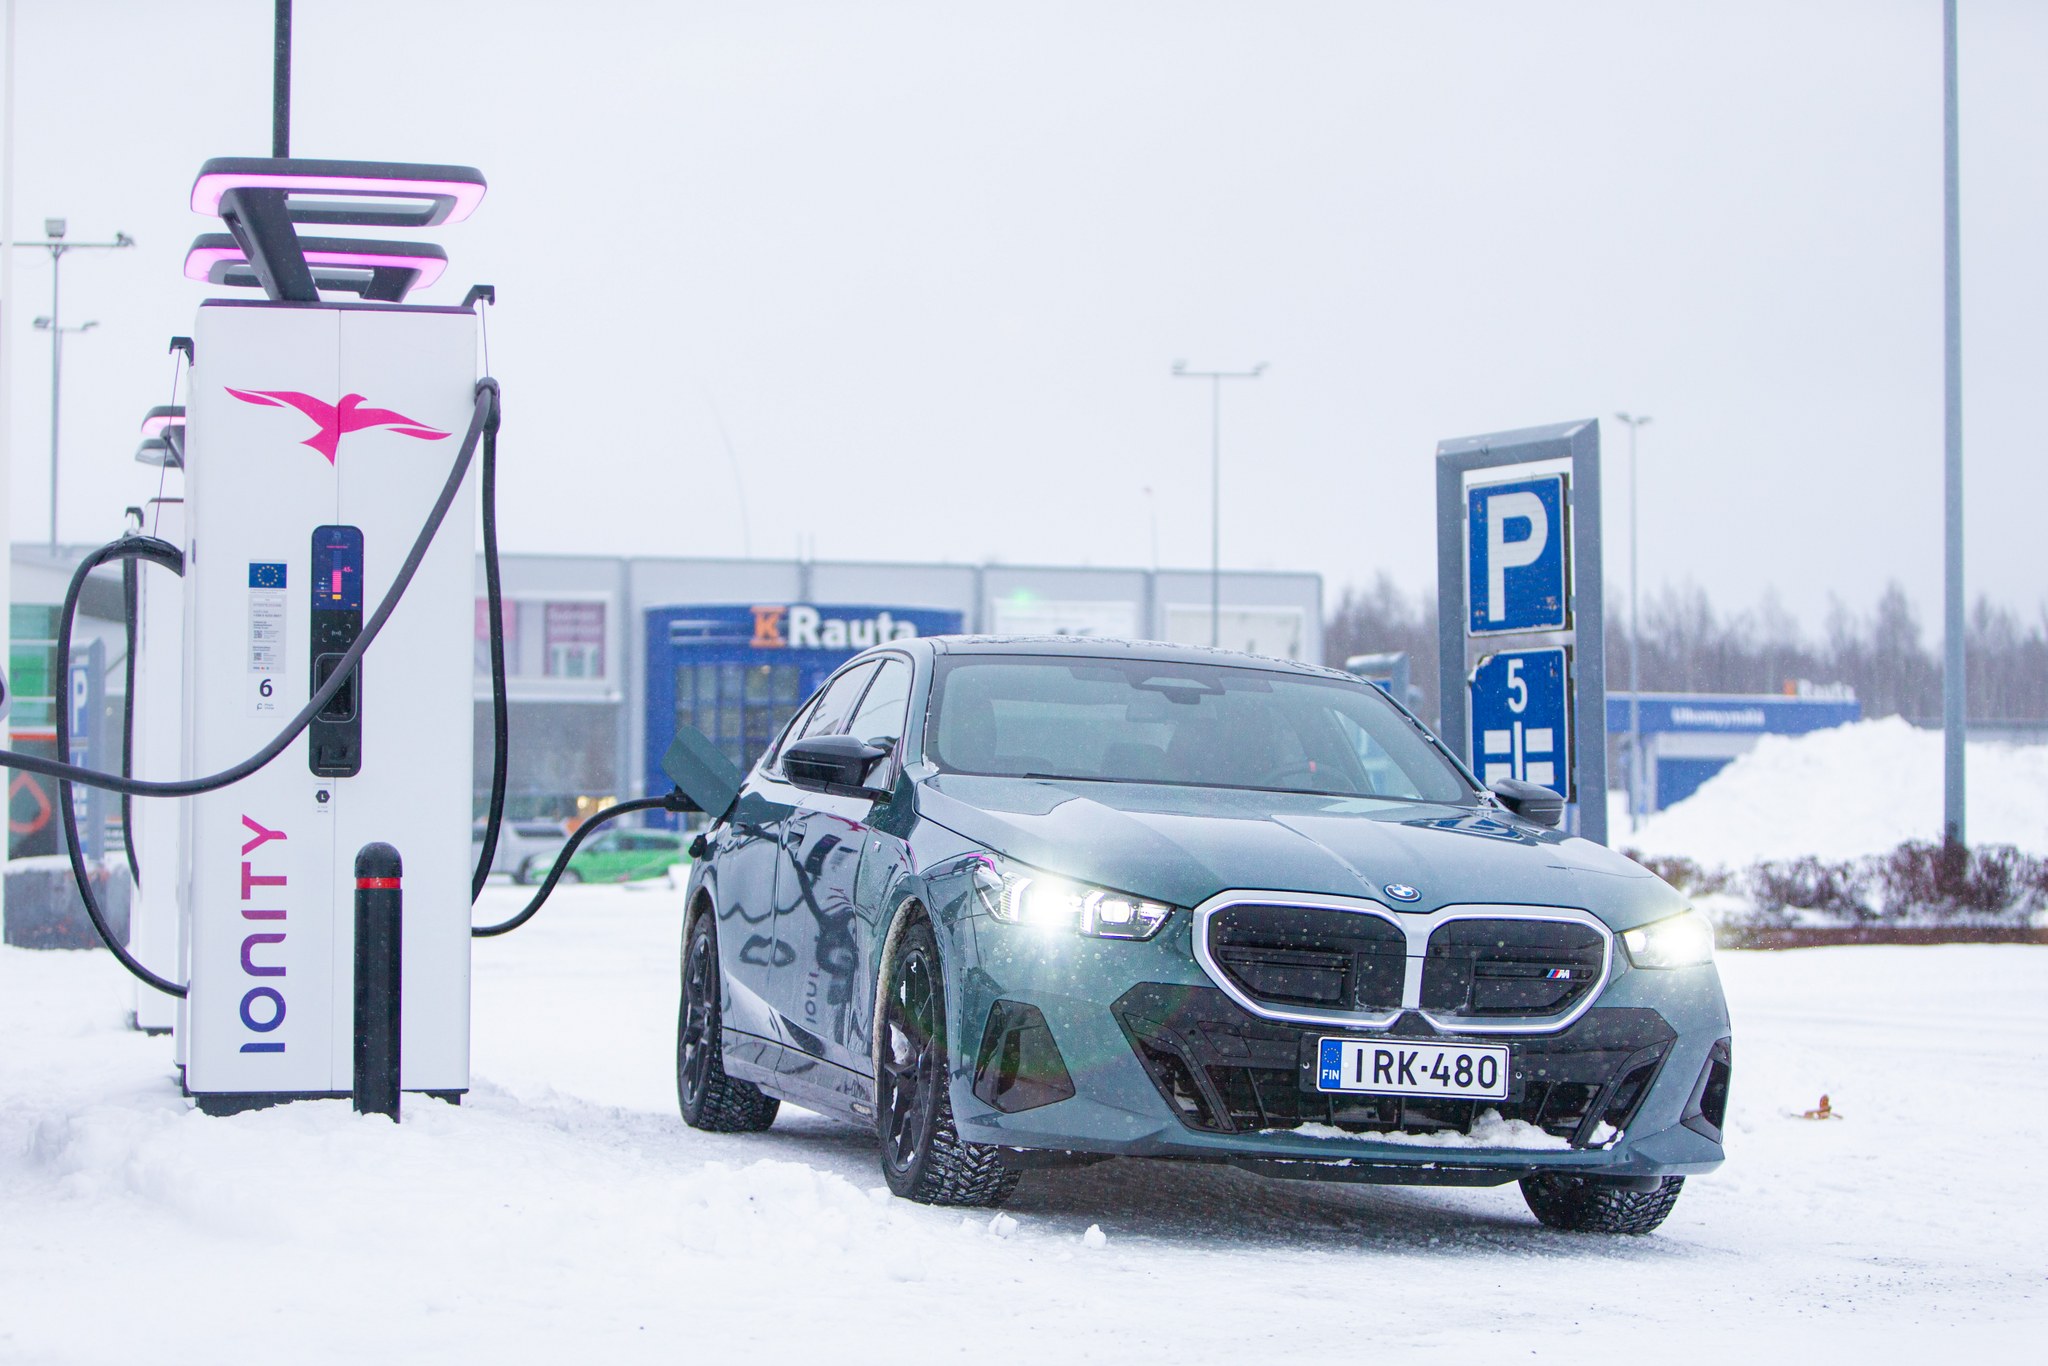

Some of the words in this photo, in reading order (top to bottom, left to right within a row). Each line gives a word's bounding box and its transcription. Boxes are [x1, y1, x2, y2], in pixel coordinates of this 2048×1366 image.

[1487, 491, 1548, 622] P
[788, 605, 918, 648] Rauta
[72, 668, 89, 735] P
[259, 678, 273, 697] 6
[1507, 658, 1529, 714] 5
[239, 813, 288, 1054] IONITY
[1322, 1069, 1340, 1081] FIN
[1355, 1048, 1498, 1089] IRK-480
